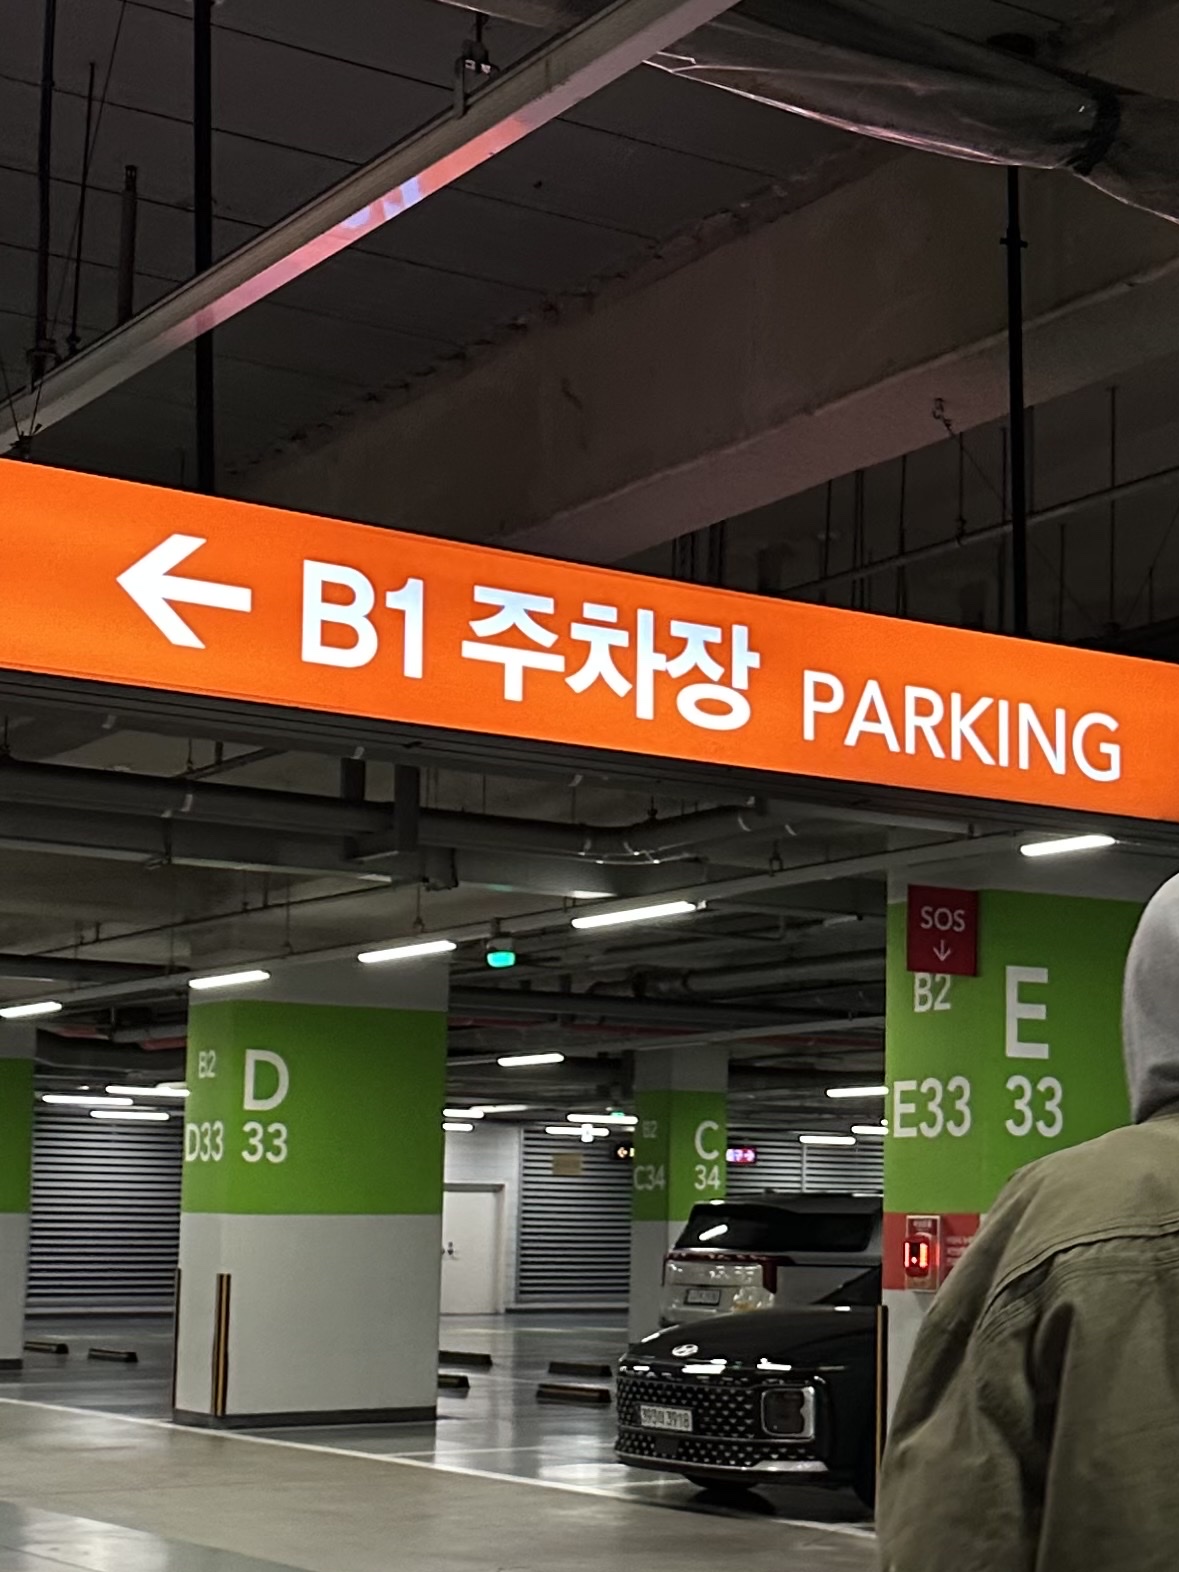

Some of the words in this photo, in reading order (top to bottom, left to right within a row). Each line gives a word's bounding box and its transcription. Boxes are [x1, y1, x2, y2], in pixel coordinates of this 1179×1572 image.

[301, 558, 424, 679] B1
[461, 585, 760, 732] 주차장
[803, 671, 1122, 782] PARKING
[920, 906, 966, 932] SOS
[913, 973, 951, 1012] B2
[1005, 965, 1049, 1059] E
[198, 1050, 216, 1079] B2
[243, 1049, 289, 1111] D
[893, 1076, 971, 1138] E33
[1005, 1075, 1063, 1138] 33
[184, 1121, 224, 1162] D33
[241, 1122, 288, 1163] 33
[694, 1120, 719, 1160] C
[633, 1165, 666, 1190] C34
[694, 1164, 721, 1190] 34
